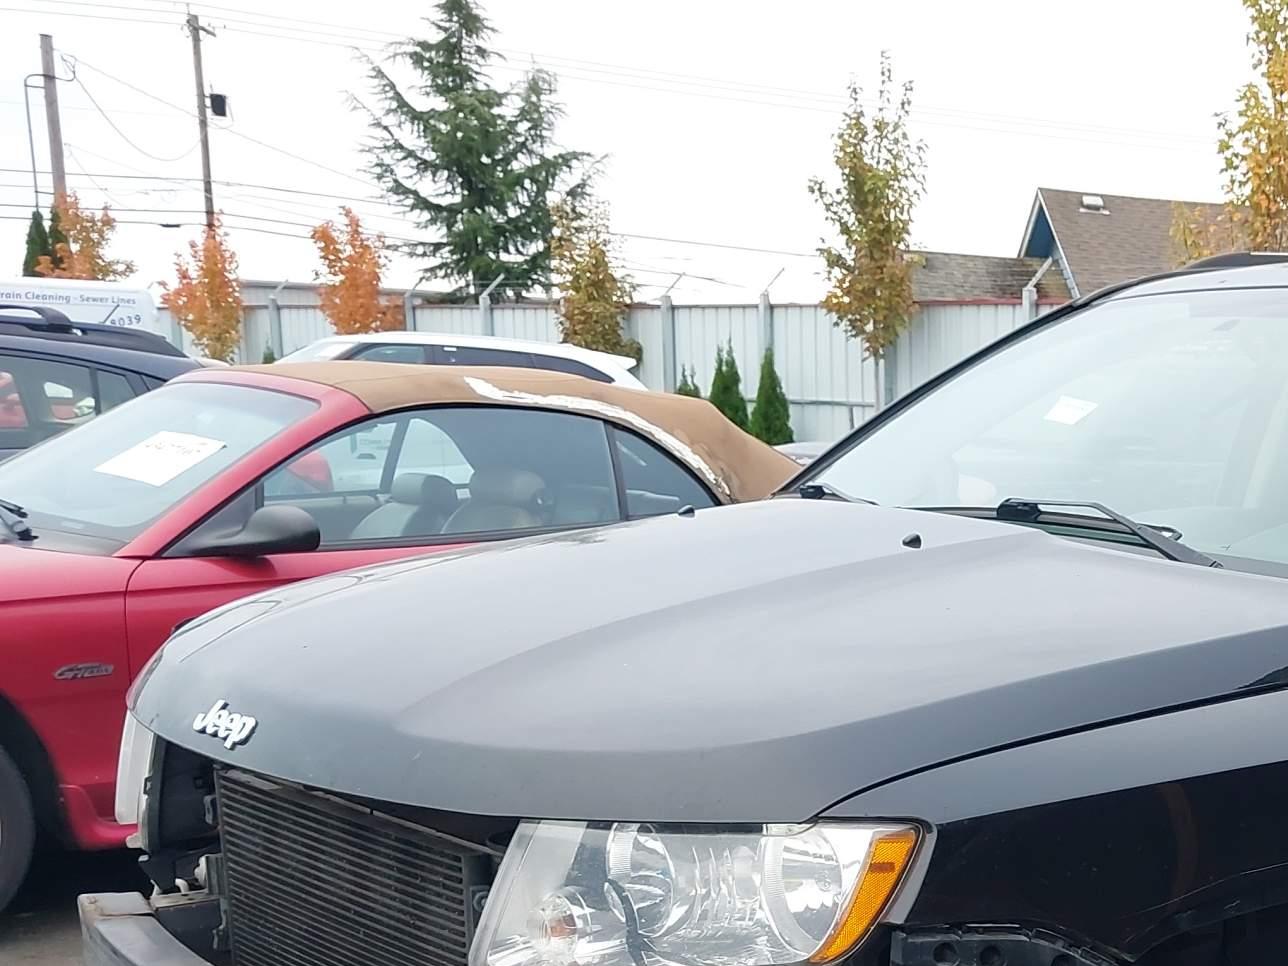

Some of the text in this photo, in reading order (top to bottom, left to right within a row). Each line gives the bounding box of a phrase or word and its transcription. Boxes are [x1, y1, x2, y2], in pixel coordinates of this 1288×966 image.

[0, 290, 22, 300] rain
[24, 291, 71, 304] Cleaning
[79, 294, 109, 304] Sewer
[111, 295, 137, 305] Lines
[192, 698, 258, 750] Jeep
